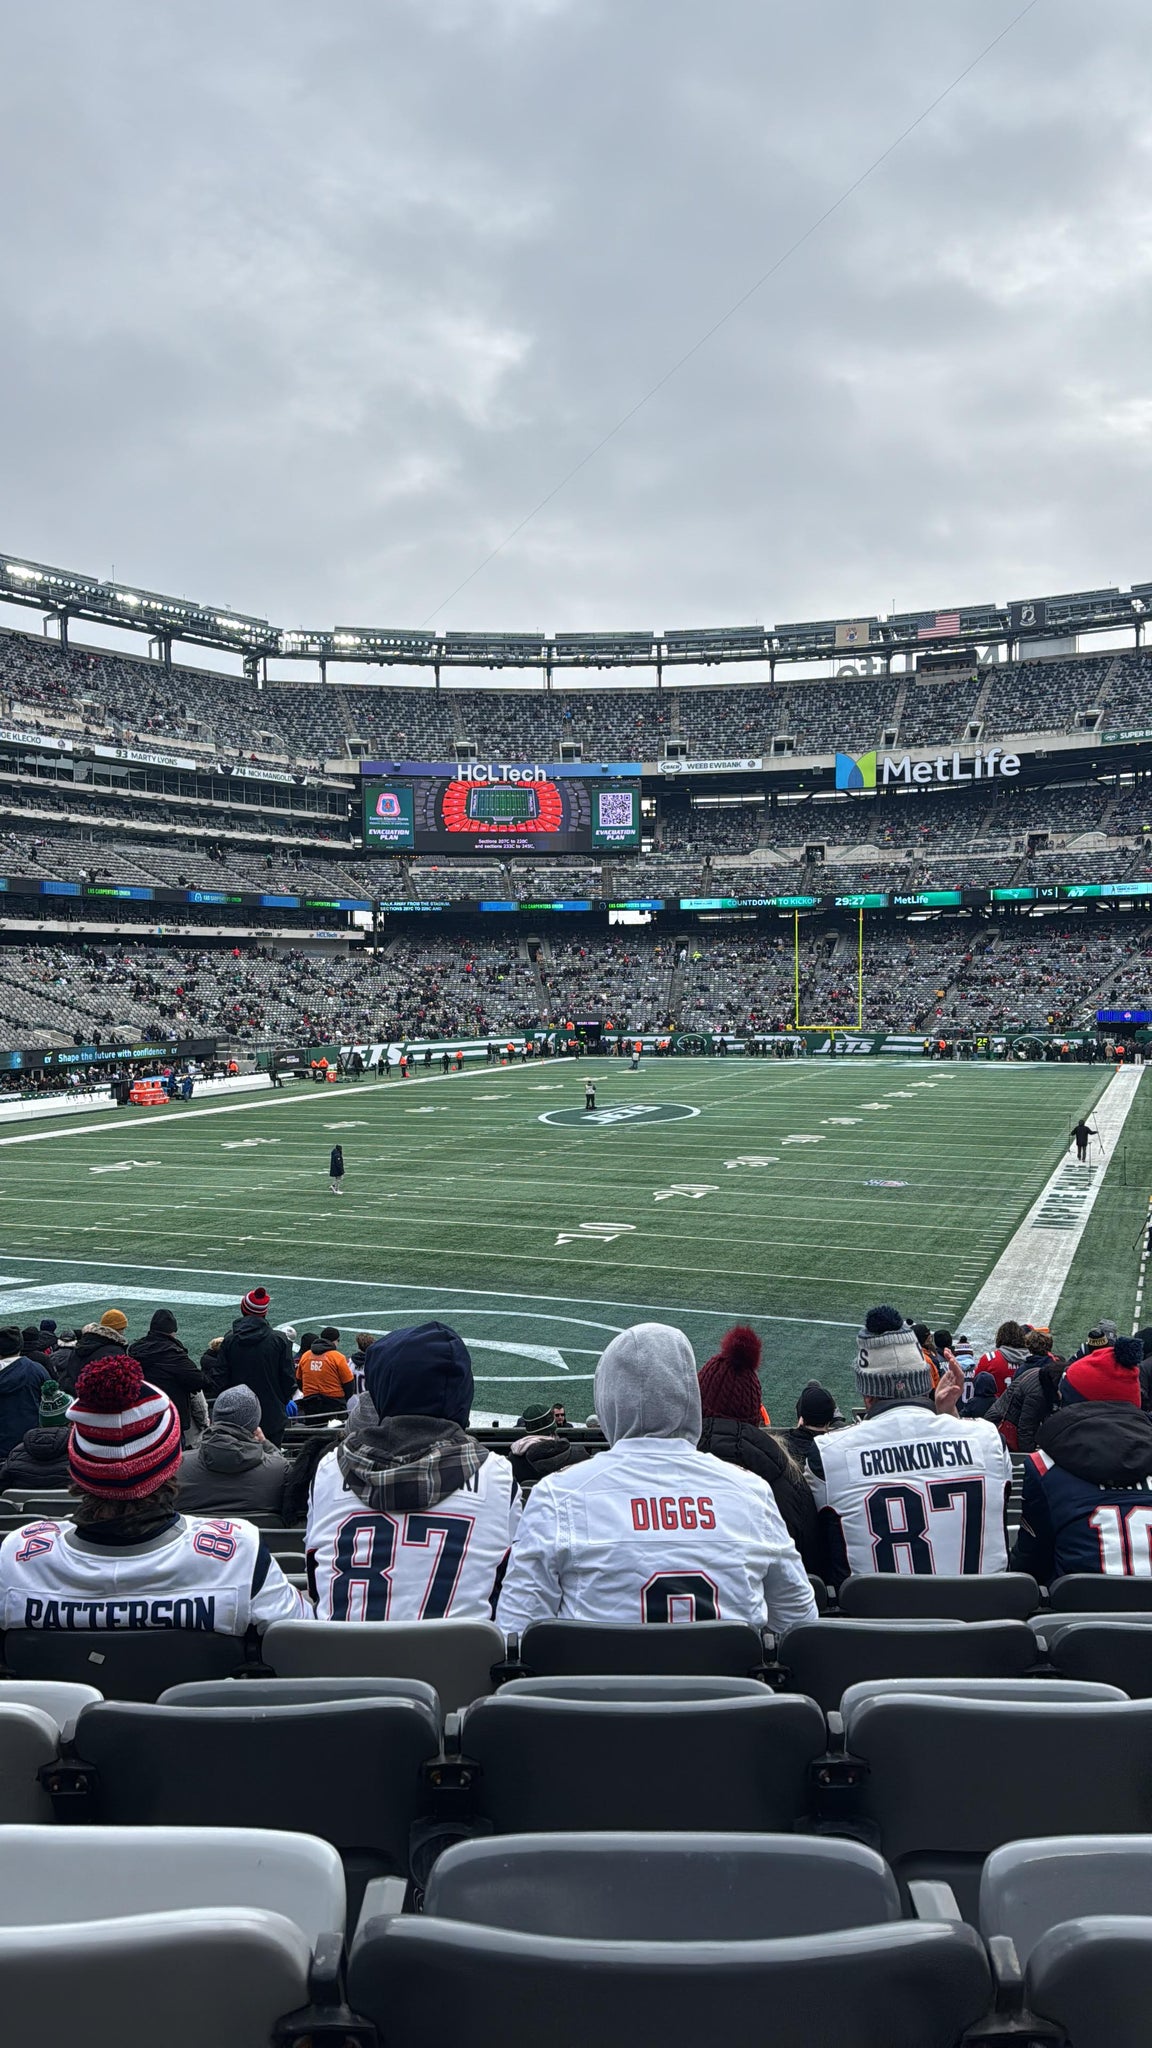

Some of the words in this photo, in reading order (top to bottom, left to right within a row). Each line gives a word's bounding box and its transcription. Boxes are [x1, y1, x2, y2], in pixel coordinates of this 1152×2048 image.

[13, 733, 41, 745] KLECKO
[1120, 730, 1144, 739] SUPER
[115, 749, 128, 759] 93
[131, 752, 157, 763] MARTY
[158, 756, 178, 766] LYONS
[457, 764, 547, 782] HCLTech
[687, 762, 708, 770] WEEB
[709, 761, 742, 769] EWBANK
[883, 747, 1021, 785] MetLife
[235, 767, 247, 776] 74
[248, 770, 262, 778] NICK
[262, 771, 292, 782] MANGOLD
[368, 828, 410, 836] EVACUATION
[893, 895, 929, 905] MetLife
[1041, 888, 1053, 897] VS
[727, 899, 777, 907] COUNTDOWN
[790, 897, 822, 905] KICKOFF
[834, 897, 866, 906] 29:27
[976, 1037, 988, 1047] 25
[44, 1056, 52, 1064] EY
[58, 1053, 79, 1064] Shape
[81, 1053, 92, 1061] the
[94, 1051, 116, 1060] future
[117, 1050, 132, 1058] with
[133, 1047, 167, 1057] confidence
[653, 1184, 720, 1199] 20
[1031, 1193, 1088, 1230] INSPIRE
[556, 1222, 637, 1243] 10
[310, 1360, 323, 1372] 662
[859, 1440, 973, 1477] GRONKOWSKI
[630, 1496, 717, 1531] DIGGS
[864, 1476, 986, 1575] 87
[328, 1511, 476, 1622] 87
[24, 1595, 215, 1631] PATTERSON
